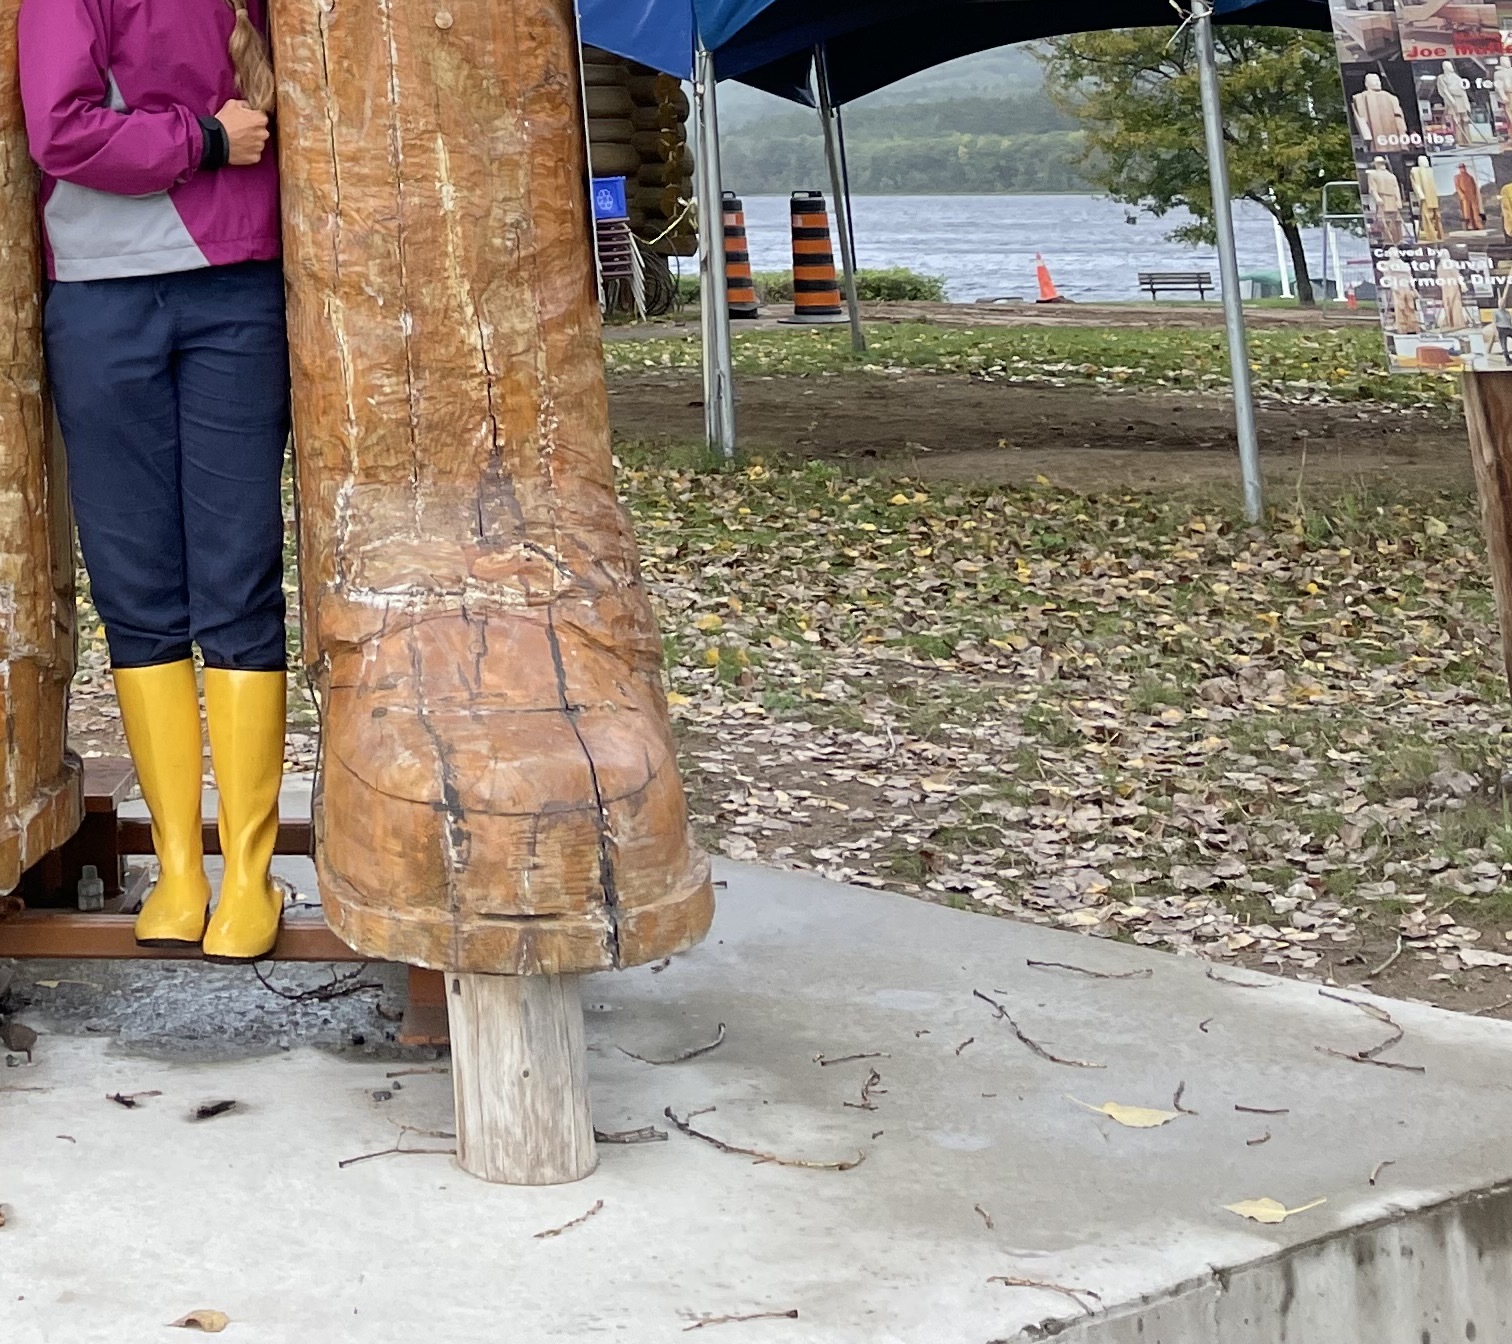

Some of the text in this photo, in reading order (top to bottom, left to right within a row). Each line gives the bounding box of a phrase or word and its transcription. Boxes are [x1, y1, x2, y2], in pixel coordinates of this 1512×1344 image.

[1406, 45, 1447, 58] Joe
[1376, 132, 1455, 146] 6000 lbs
[1427, 247, 1444, 258] by
[1441, 257, 1494, 271] Duval
[1379, 274, 1465, 288] Clermont
